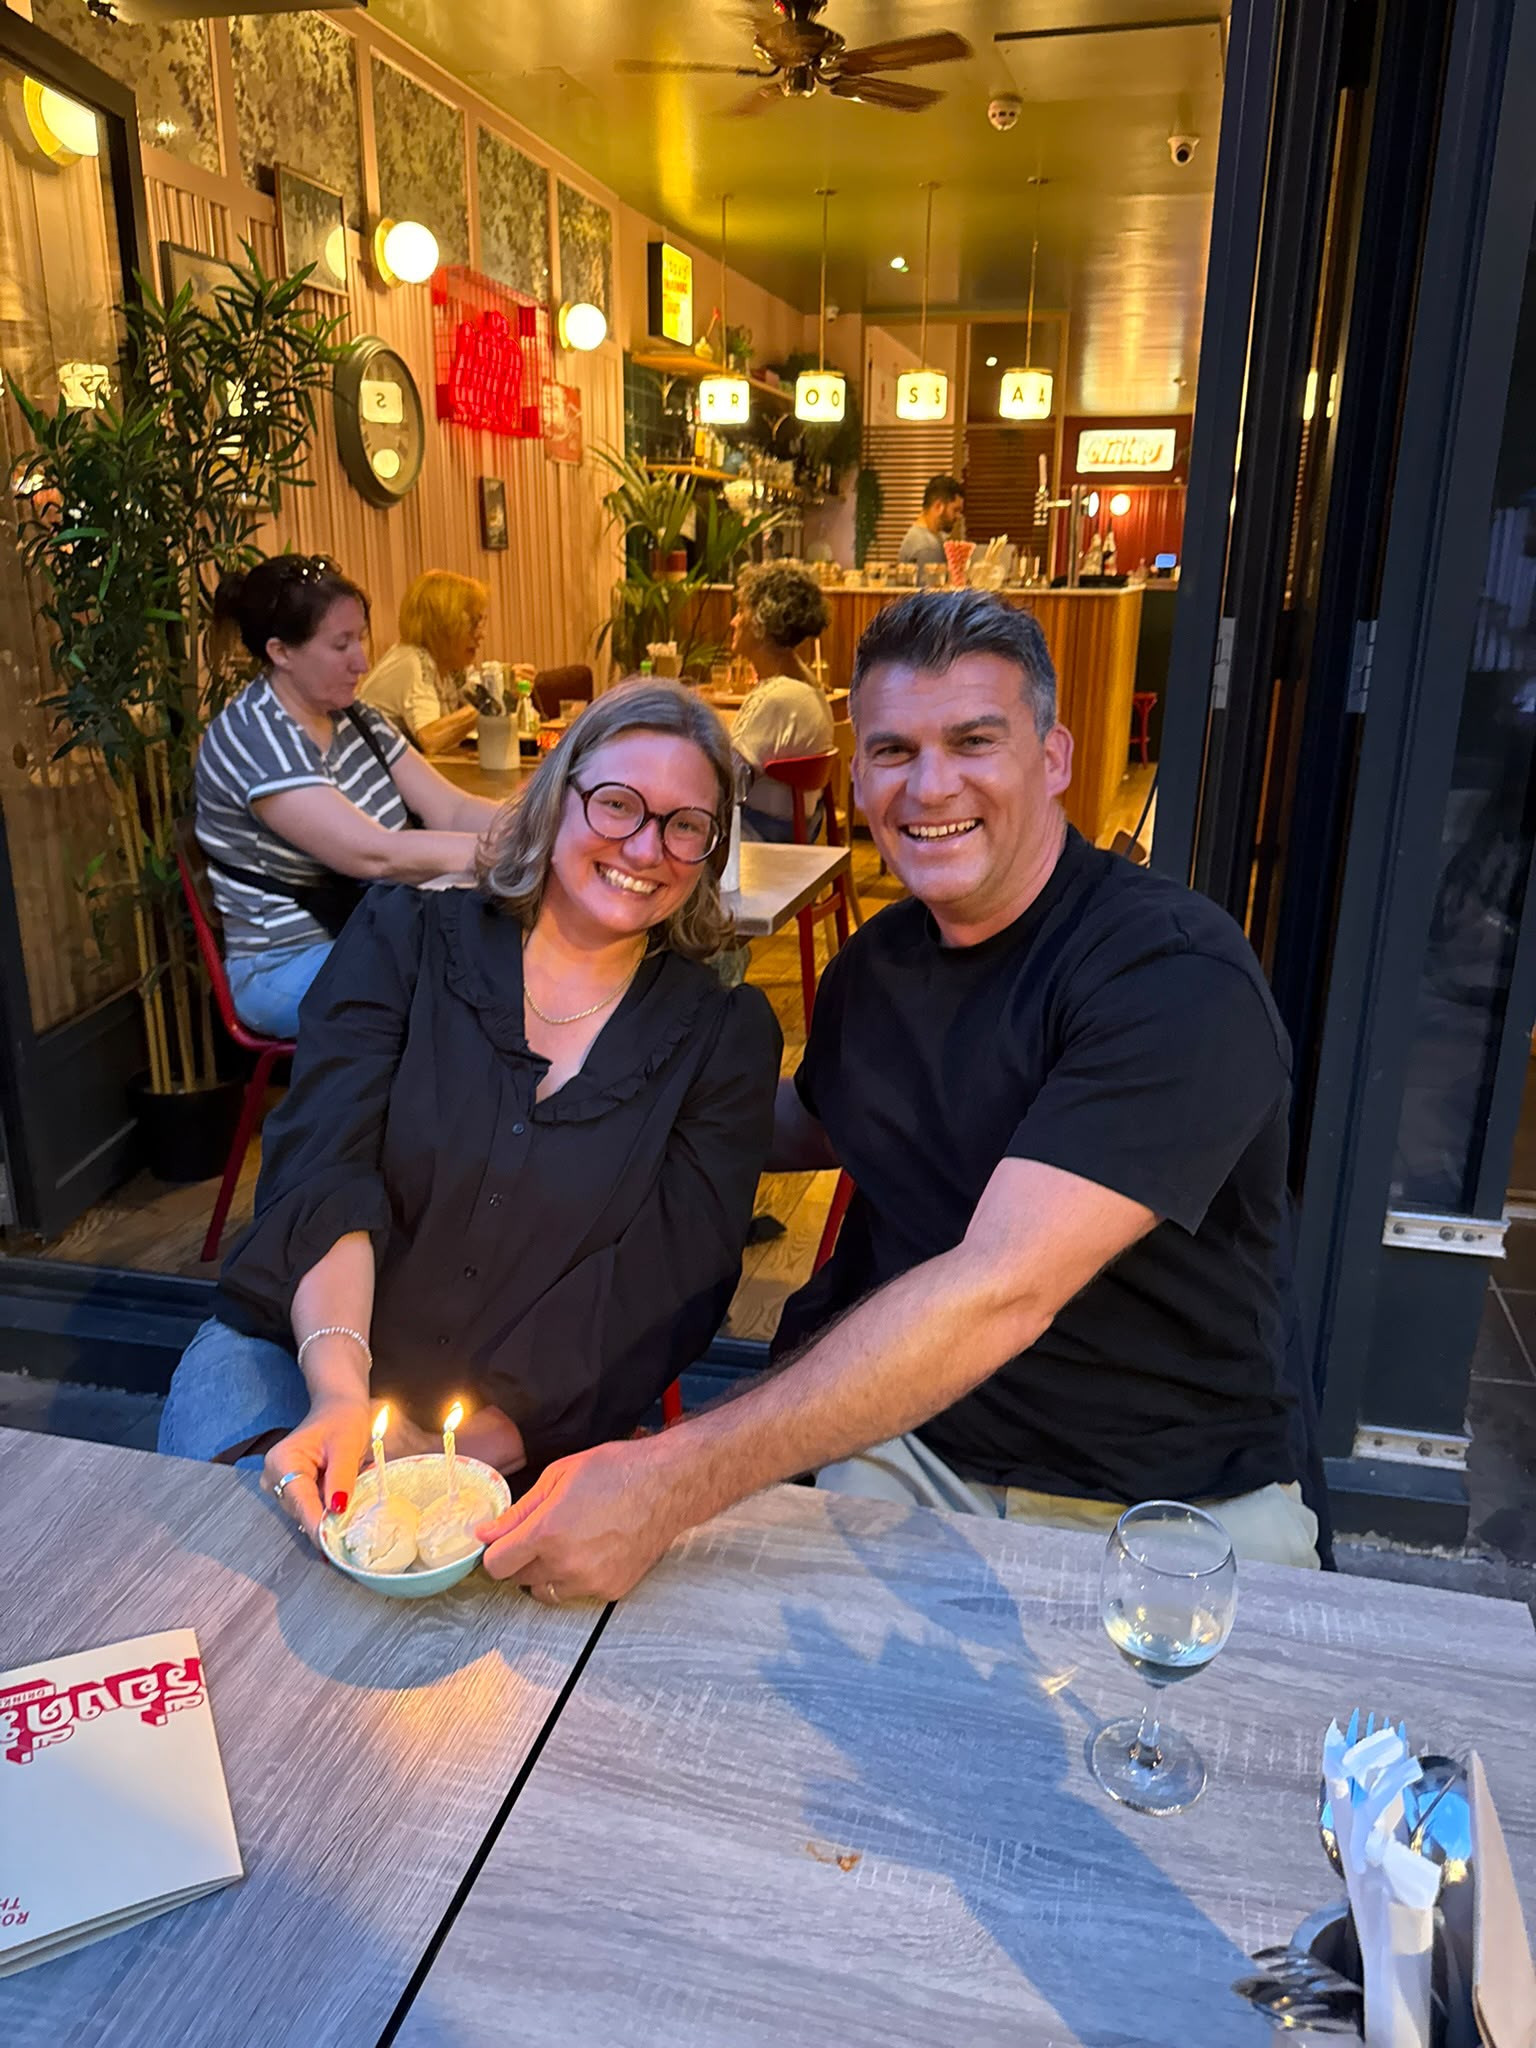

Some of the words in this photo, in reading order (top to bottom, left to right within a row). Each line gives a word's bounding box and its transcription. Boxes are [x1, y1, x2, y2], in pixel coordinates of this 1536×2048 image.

[805, 389, 819, 405] O
[909, 387, 918, 404] S
[1012, 386, 1024, 403] A
[0, 1657, 206, 1764] รื่องดื่
[0, 1911, 30, 1928] RO
